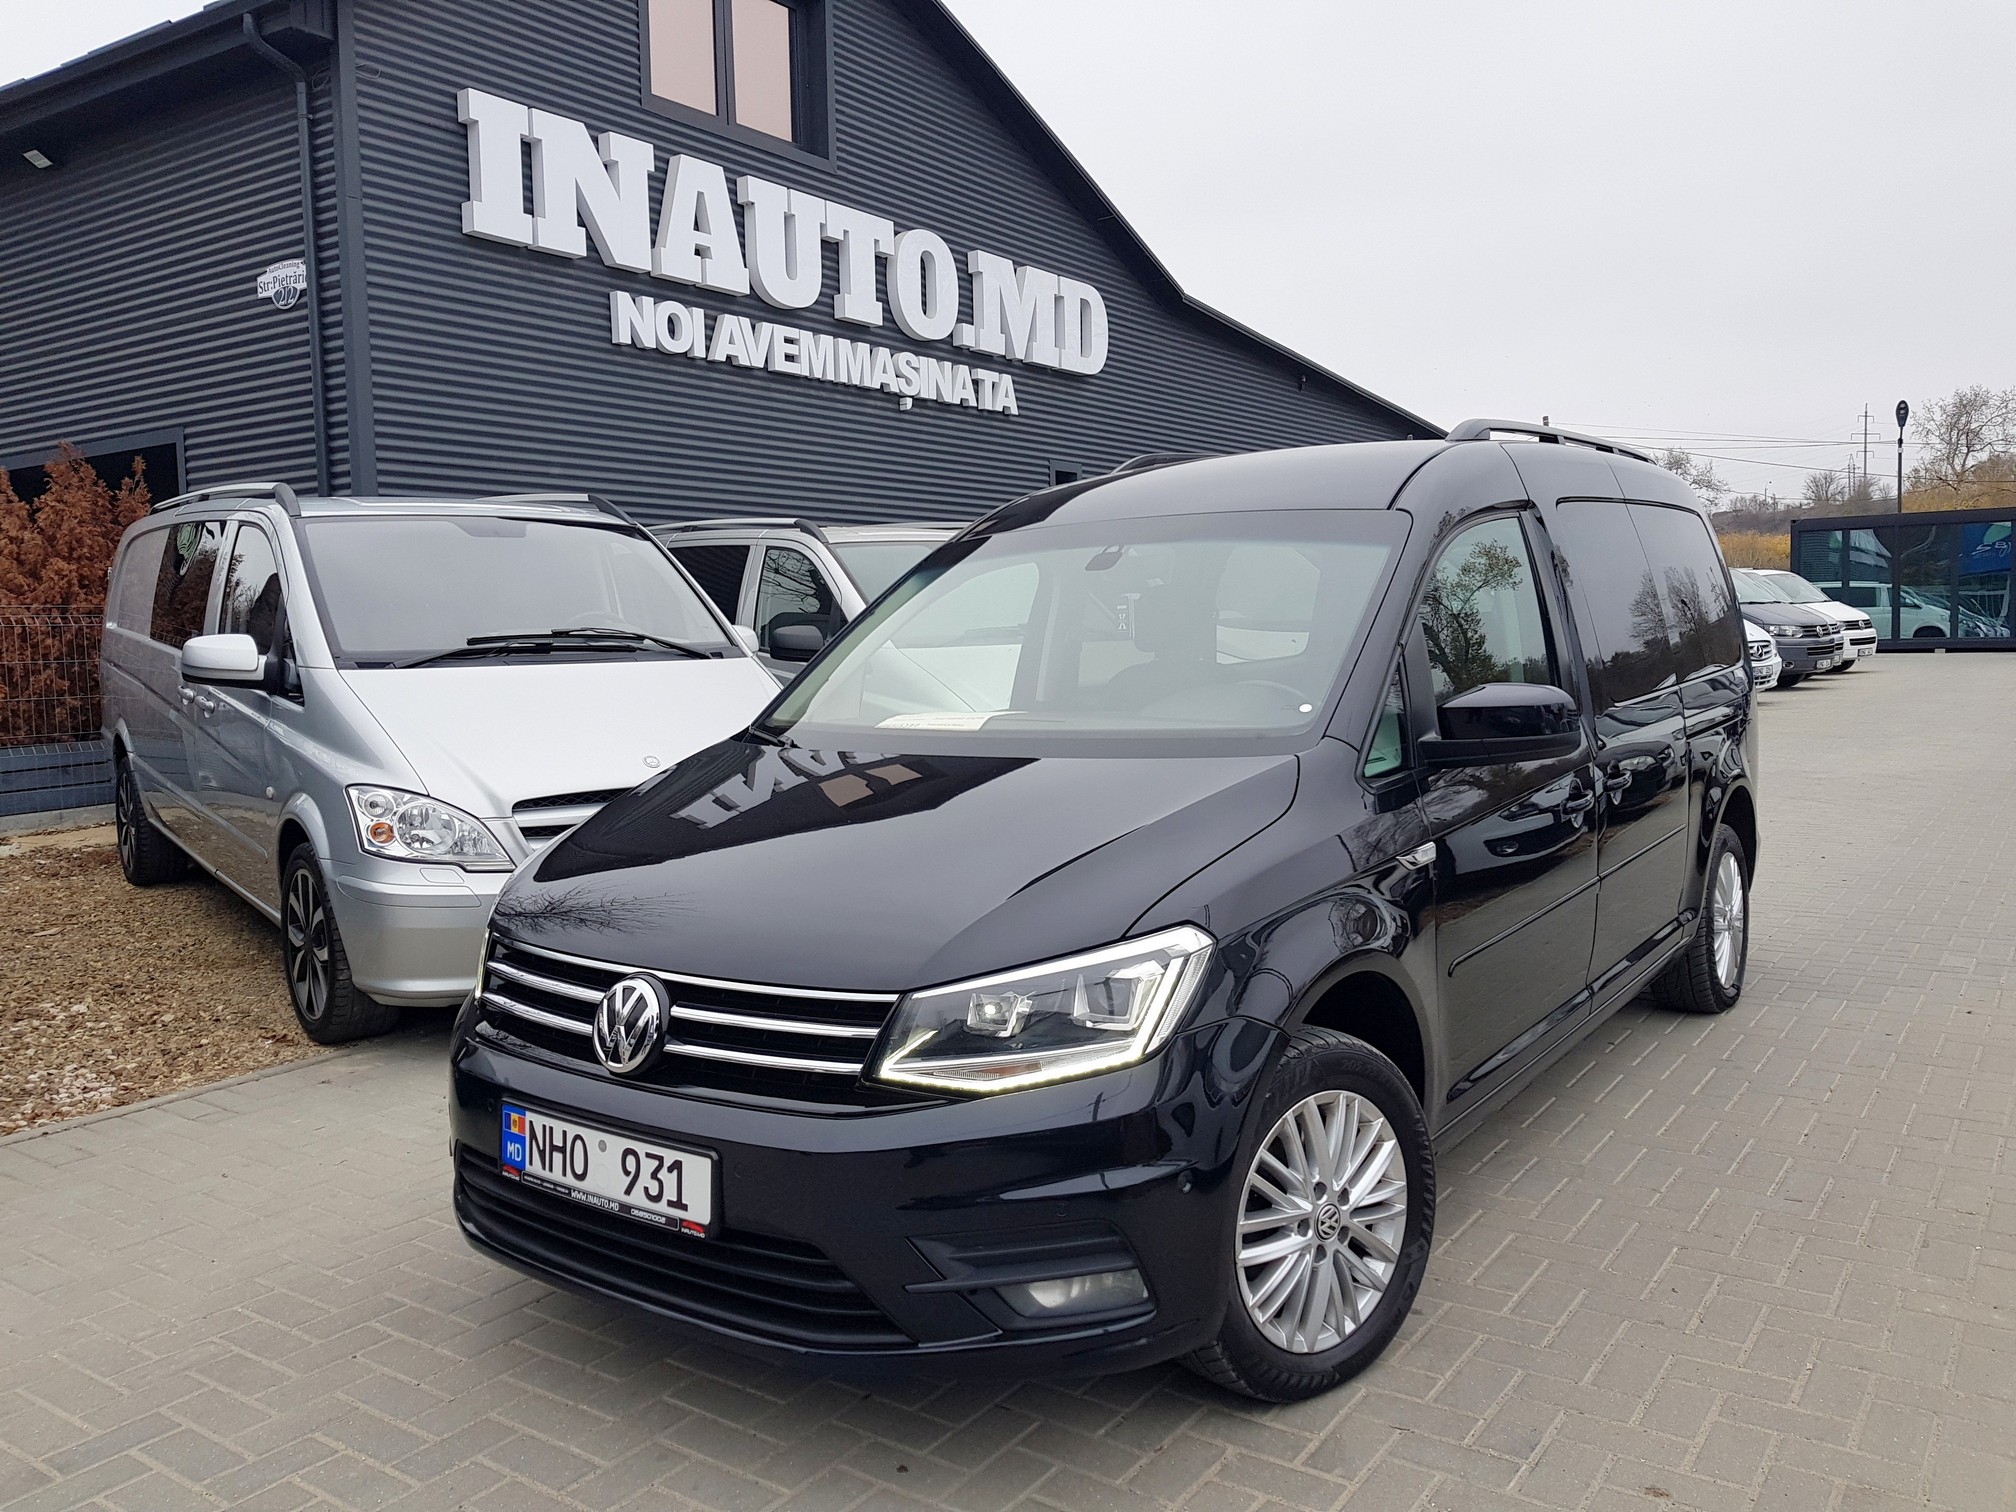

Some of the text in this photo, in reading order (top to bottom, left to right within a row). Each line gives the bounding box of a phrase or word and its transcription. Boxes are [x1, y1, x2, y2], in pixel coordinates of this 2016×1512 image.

[457, 87, 1109, 376] INAUTO.MD
[610, 290, 706, 359] NOI
[507, 1140, 523, 1162] MD
[528, 1119, 689, 1212] NHO 931
[570, 1189, 620, 1212] WWW.INAUTO.MD
